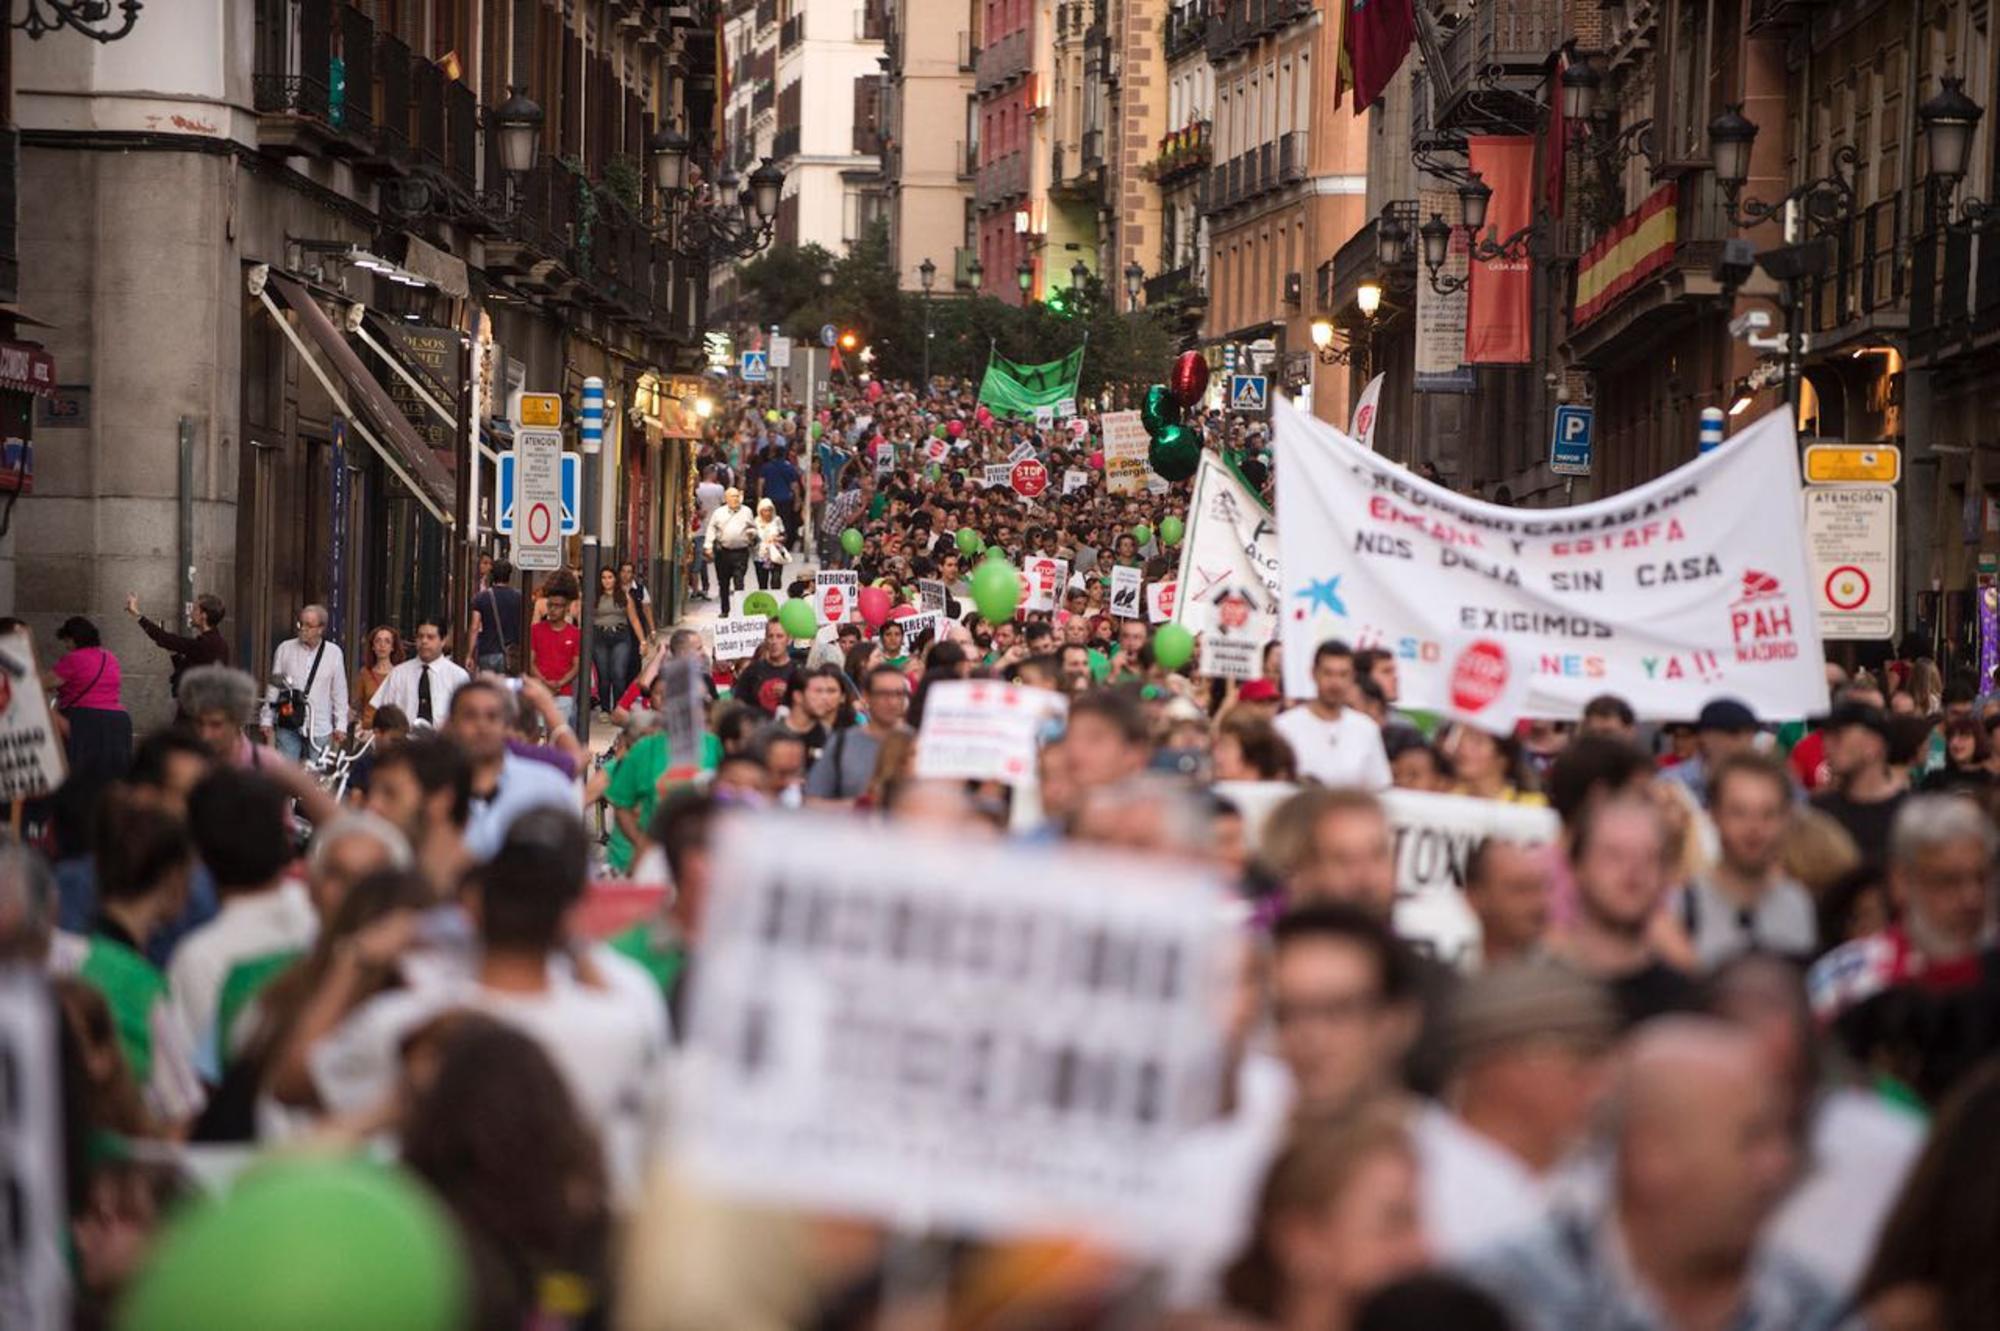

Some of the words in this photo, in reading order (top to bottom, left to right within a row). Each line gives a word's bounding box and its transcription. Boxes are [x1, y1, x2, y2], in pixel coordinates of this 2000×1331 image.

[1565, 416, 1585, 441] P
[1016, 466, 1042, 477] STOP
[1815, 490, 1883, 503] ATENCIÓN
[1551, 518, 1686, 556] ESTAFA
[1354, 530, 1414, 560] NOS
[1551, 569, 1604, 592] SIN
[1636, 554, 1723, 588] CASA
[715, 624, 729, 636] Las
[903, 616, 936, 632] ERECH
[1460, 606, 1614, 639] EXIGIMOS
[1731, 606, 1793, 643] PAH
[1735, 641, 1799, 663] MADRID
